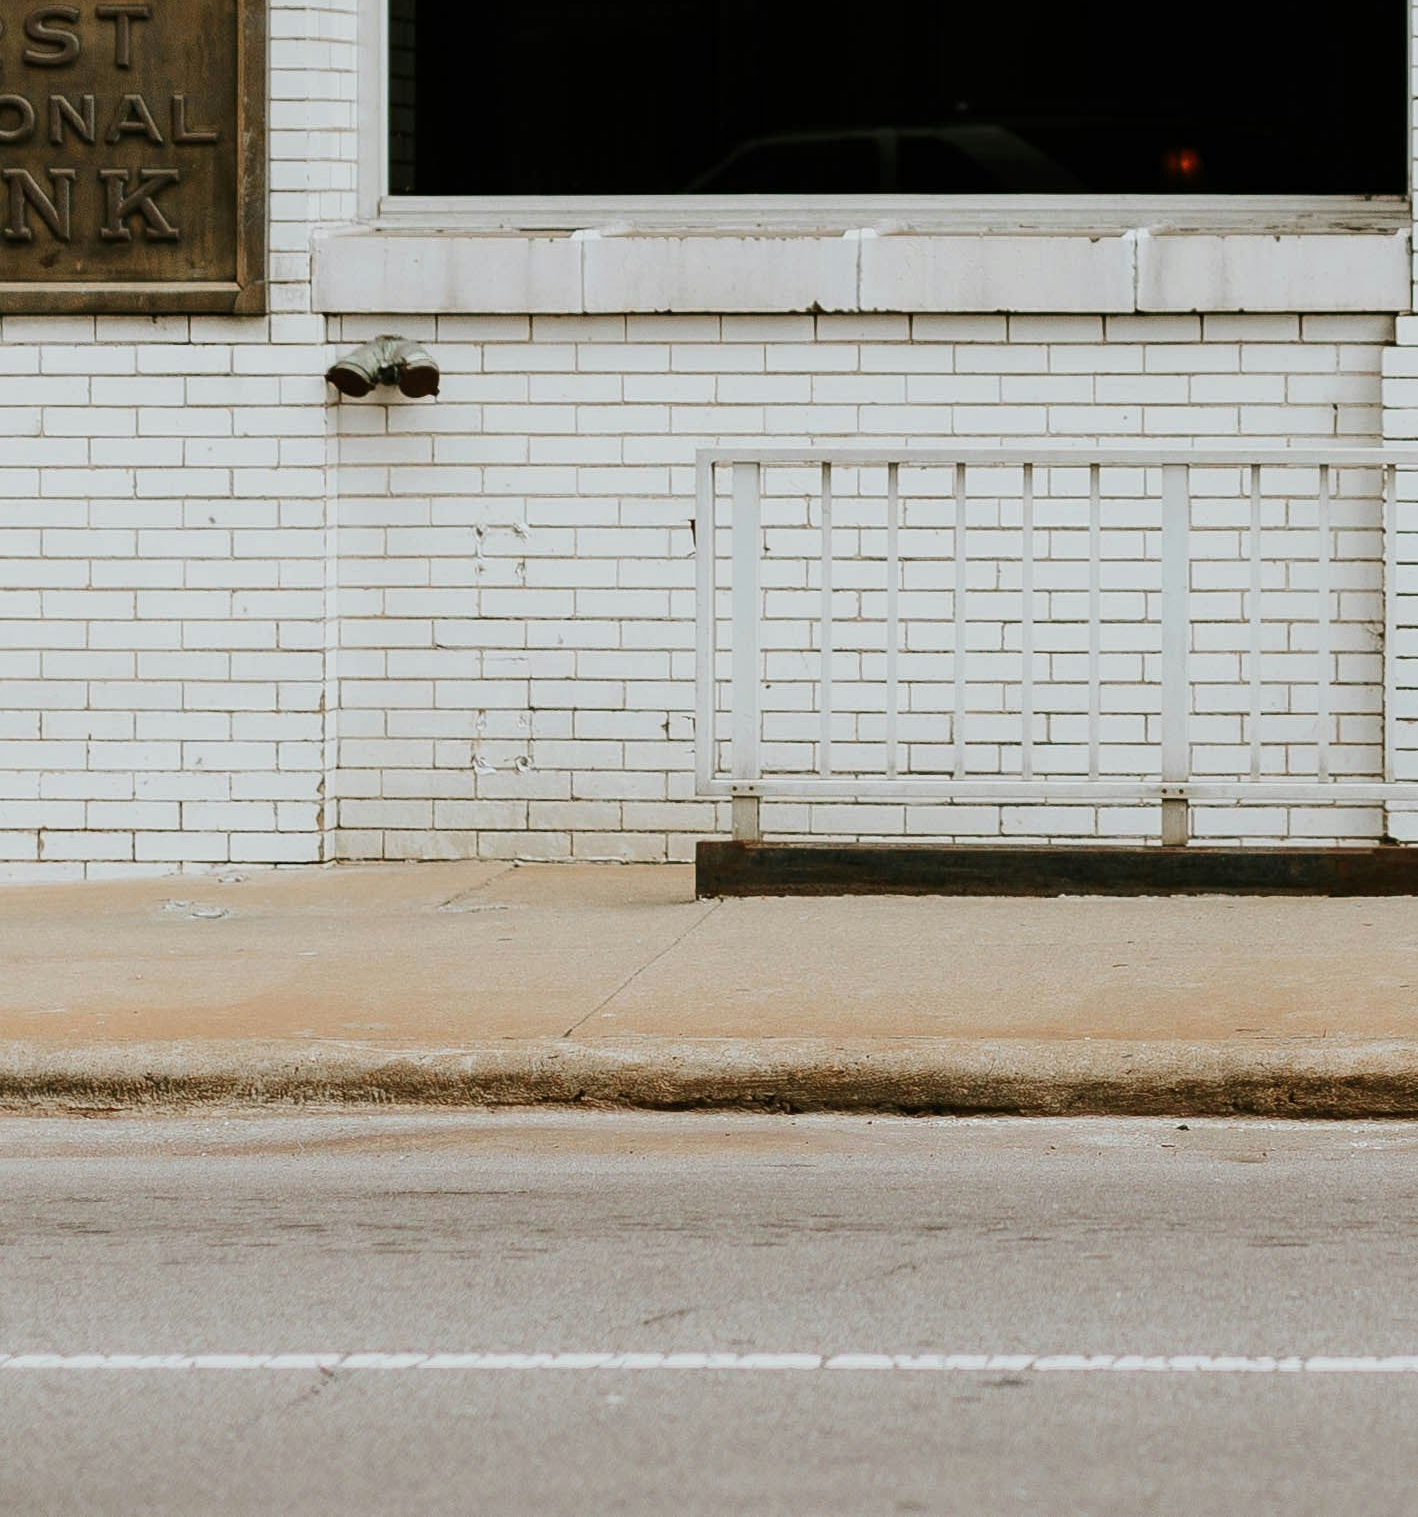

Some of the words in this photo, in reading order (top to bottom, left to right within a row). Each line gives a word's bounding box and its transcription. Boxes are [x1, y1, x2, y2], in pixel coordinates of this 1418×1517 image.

[0, 3, 151, 70] ST
[0, 93, 218, 145] ONAL
[3, 167, 180, 243] NK
